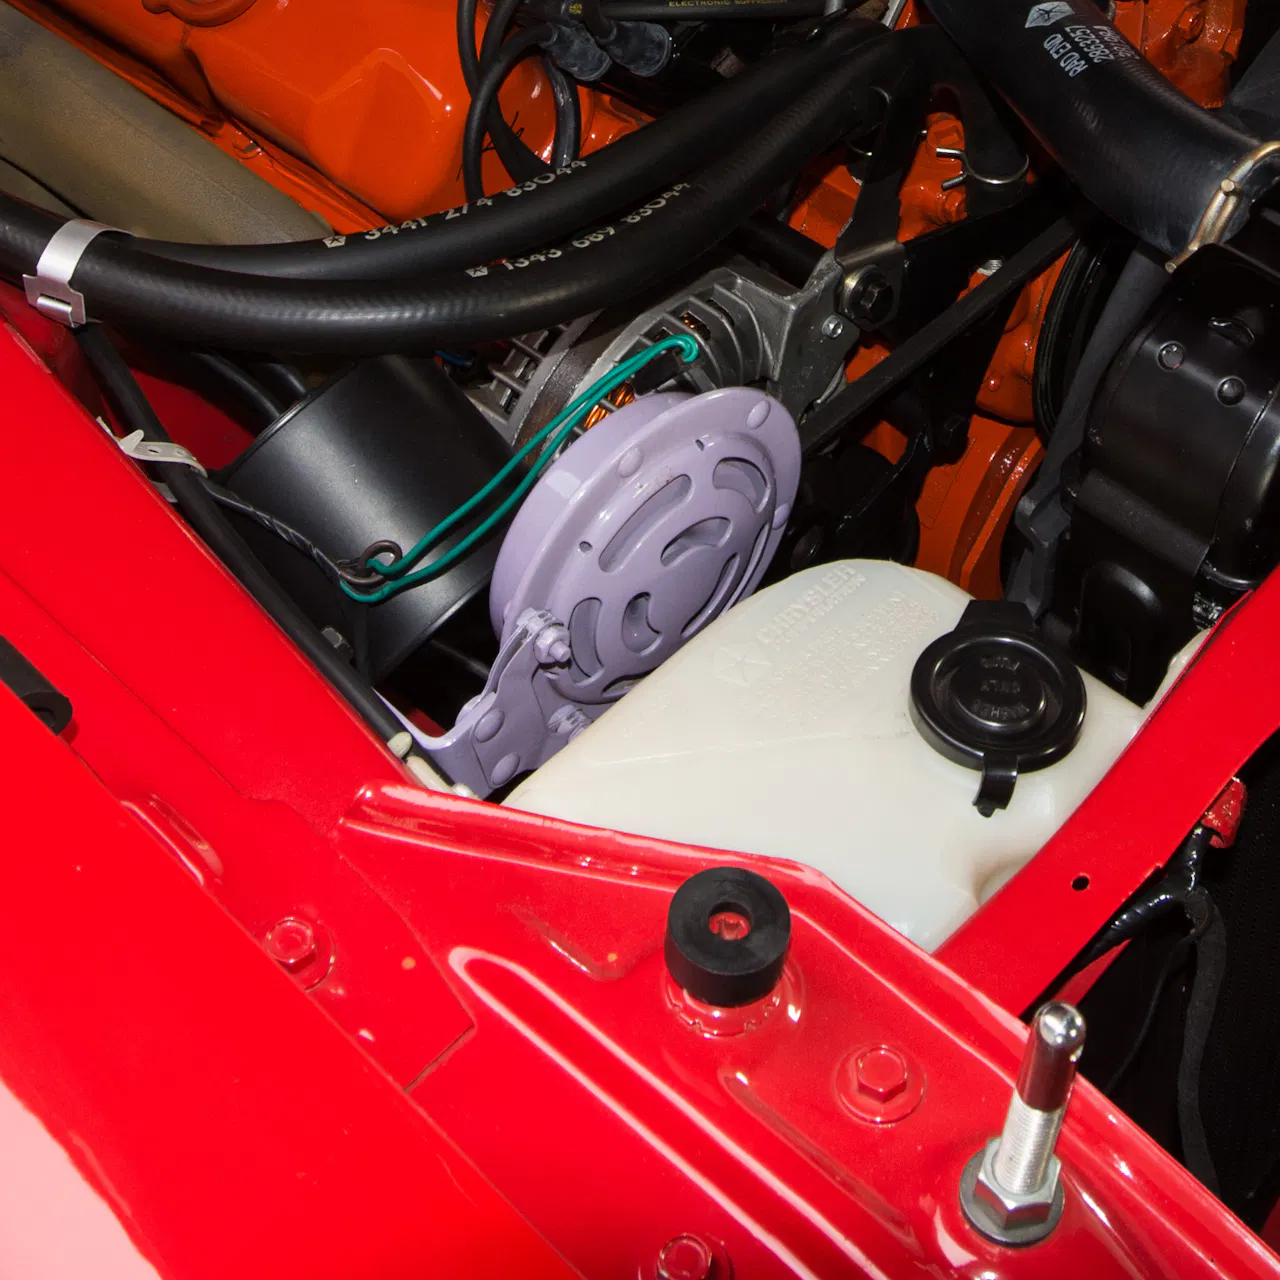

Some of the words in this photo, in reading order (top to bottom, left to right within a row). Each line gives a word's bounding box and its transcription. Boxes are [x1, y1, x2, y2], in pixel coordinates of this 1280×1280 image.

[669, 0, 731, 8] ELECTRONIC
[1043, 33, 1072, 60] END
[1065, 25, 1116, 63] 2863257
[1060, 52, 1088, 77] RAD
[365, 217, 428, 240] 3441
[503, 159, 588, 197] 83044
[502, 248, 563, 270] 1343
[757, 564, 857, 644] CHRYSLER
